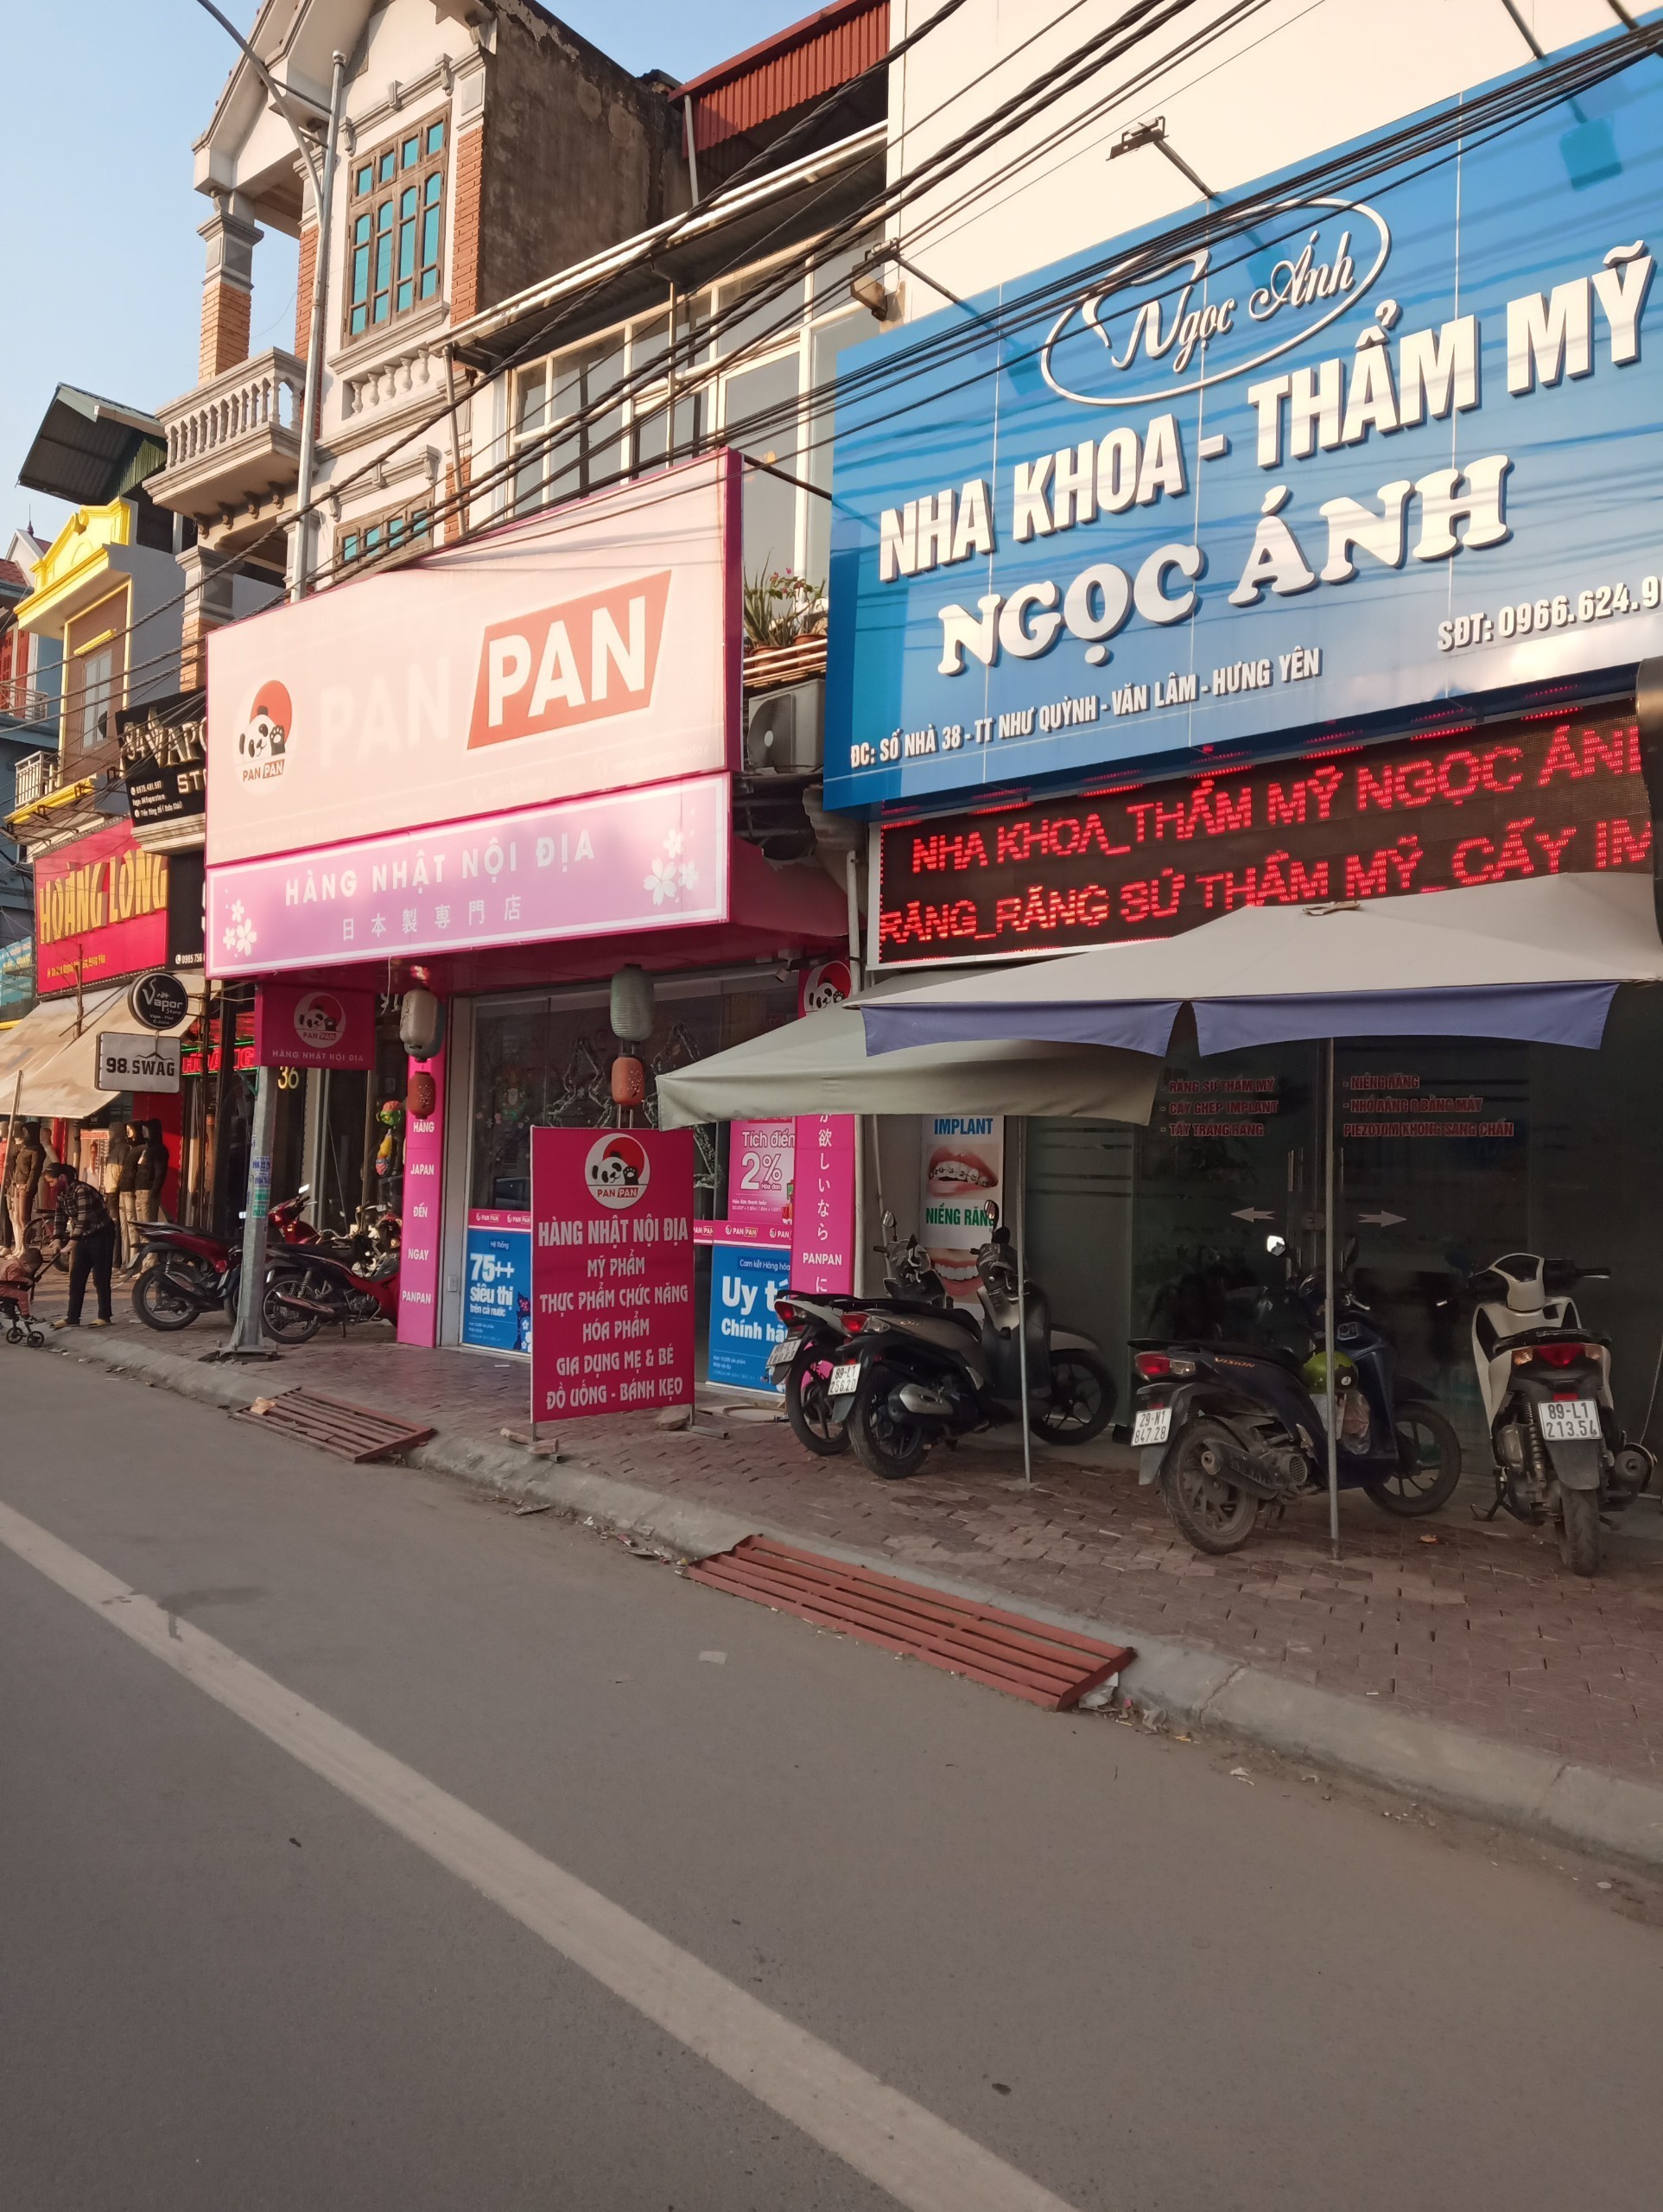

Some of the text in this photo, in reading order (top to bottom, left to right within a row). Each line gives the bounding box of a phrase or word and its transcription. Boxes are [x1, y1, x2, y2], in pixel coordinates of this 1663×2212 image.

[1084, 230, 1355, 373] Ngọc Ánh
[879, 478, 995, 582] NHA
[1012, 413, 1187, 543] KHOA
[1247, 298, 1482, 469] THẨM
[1506, 239, 1653, 397] MỸ
[937, 454, 1514, 676] NGỌC ÁNH
[1437, 574, 1663, 652] SĐT: 0966.624.9
[318, 594, 646, 768] PAN PAN
[850, 645, 1323, 768] ĐC: SỐ NHÀ 38 TT NHƯ QUỲNH VĂN LÂM HƯNG YÊN
[177, 768, 206, 794] ST
[243, 760, 283, 783] PAN PAN
[911, 831, 988, 874] NHA
[1356, 746, 1524, 811] NGỌC
[284, 830, 595, 906] HÀNG NHẬT NỘI ĐỊA
[109, 848, 168, 924] LONG
[142, 977, 183, 1012] Vapor
[277, 1066, 300, 1090] 36
[1226, 1100, 1279, 1115] IMPLANT
[741, 1129, 768, 1148] Tích
[934, 1117, 993, 1135] IMPLANT
[410, 1164, 435, 1176] JAPAN
[740, 1151, 783, 1191] 2%
[597, 1188, 637, 1198] PAN PAN
[413, 1202, 428, 1218] ĐẾN
[538, 1213, 689, 1249] HÀNG NHẬT NỘI ĐỊA
[733, 1227, 757, 1236] PAN PAN
[408, 1248, 429, 1261] NGAY
[587, 1249, 645, 1279] MỸ PHẨM
[739, 1259, 752, 1268] Cam
[763, 1261, 778, 1271] Hàng
[803, 1252, 842, 1266] PANPAN
[470, 1253, 515, 1283] 75++
[402, 1290, 431, 1305] PANPAN
[469, 1283, 513, 1311] siêu thị
[469, 1303, 483, 1314] trên
[539, 1281, 689, 1318] THỰC PHẨM CHỨC NĂNG
[721, 1275, 759, 1316] Uy
[582, 1311, 650, 1344] HÓA PHẨM
[720, 1317, 787, 1344] Chính hã
[556, 1343, 674, 1379] GIA DỤNG MẸ & BÉ
[835, 1365, 856, 1380] 89-L1
[1215, 1357, 1256, 1369] VISION
[546, 1376, 683, 1410] ĐỒ UỐNG BÁNH KẸO
[1139, 1410, 1166, 1428] 29-N1
[1547, 1402, 1590, 1420] 89-L1
[1134, 1426, 1166, 1445] 847.28
[1546, 1420, 1598, 1439] 213.54
